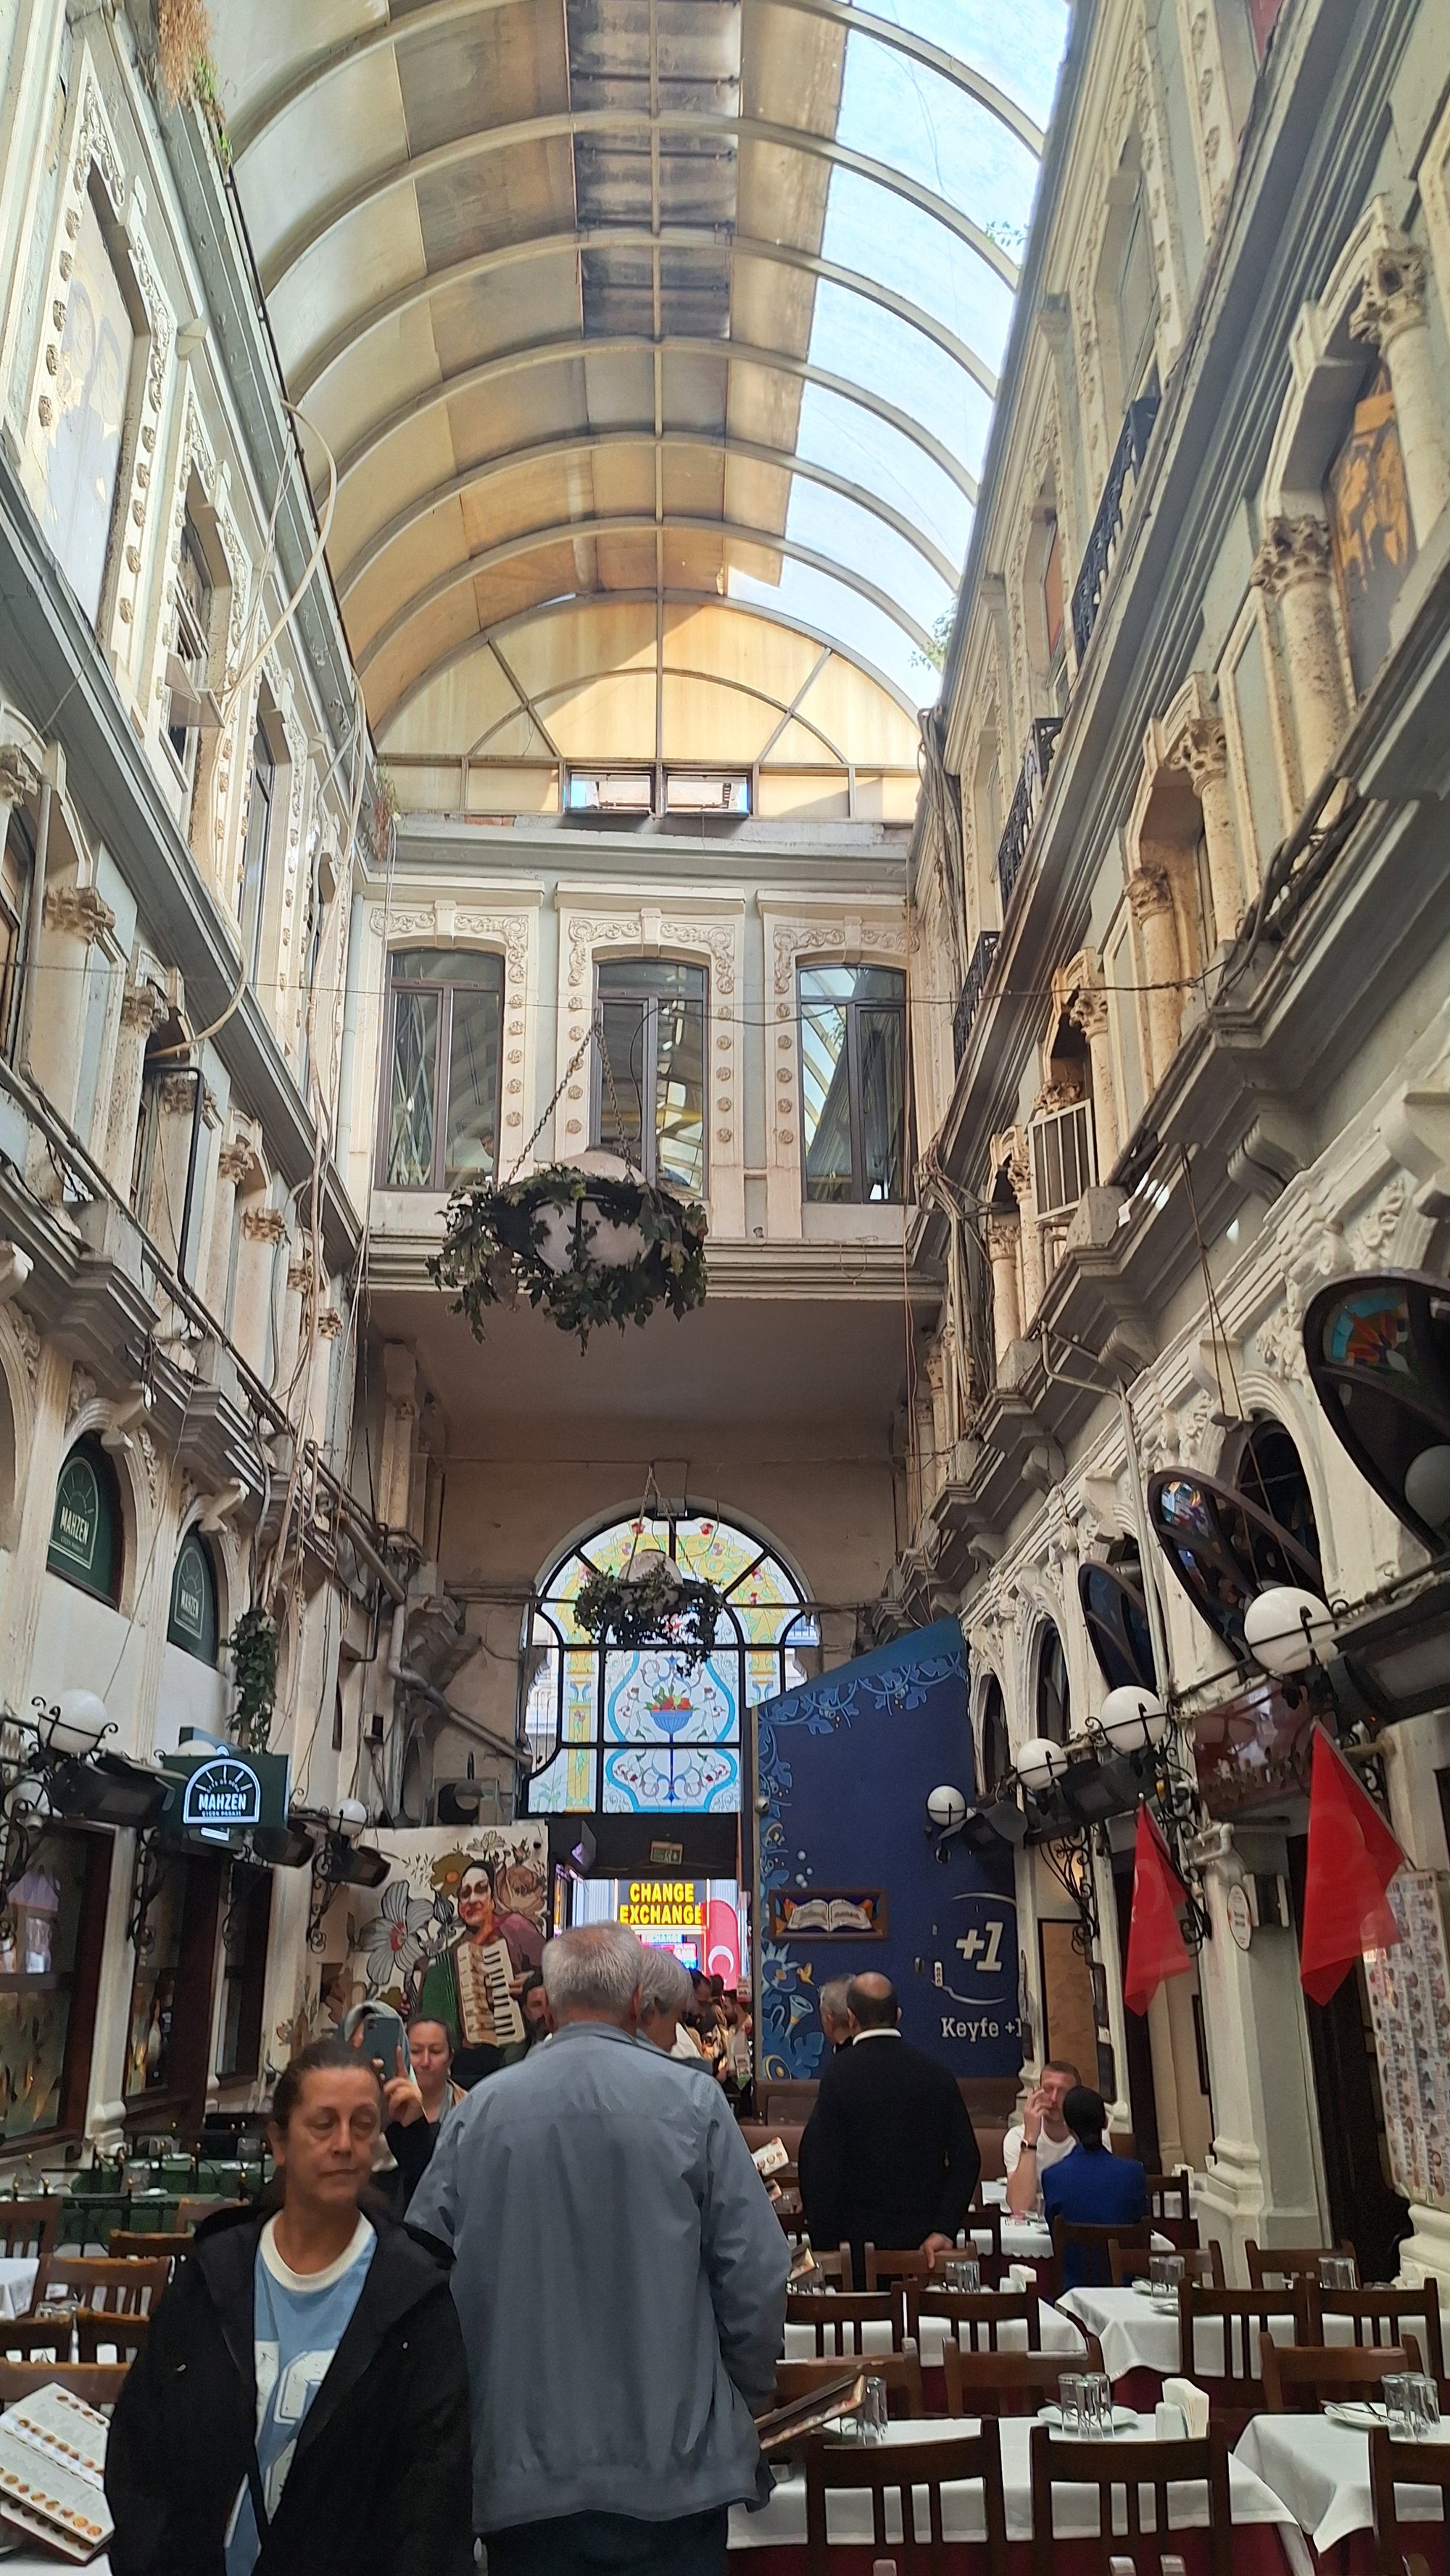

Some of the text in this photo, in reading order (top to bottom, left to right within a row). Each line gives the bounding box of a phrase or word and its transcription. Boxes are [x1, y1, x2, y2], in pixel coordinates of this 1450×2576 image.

[59, 1505, 90, 1545] MAHZEN
[198, 1793, 246, 1811] MAHZEN
[629, 1882, 694, 1903] CHANGE
[618, 1903, 702, 1925] EXCHANGE
[956, 1921, 1004, 1972] +1
[940, 2016, 1022, 2043] Keyfe +1
